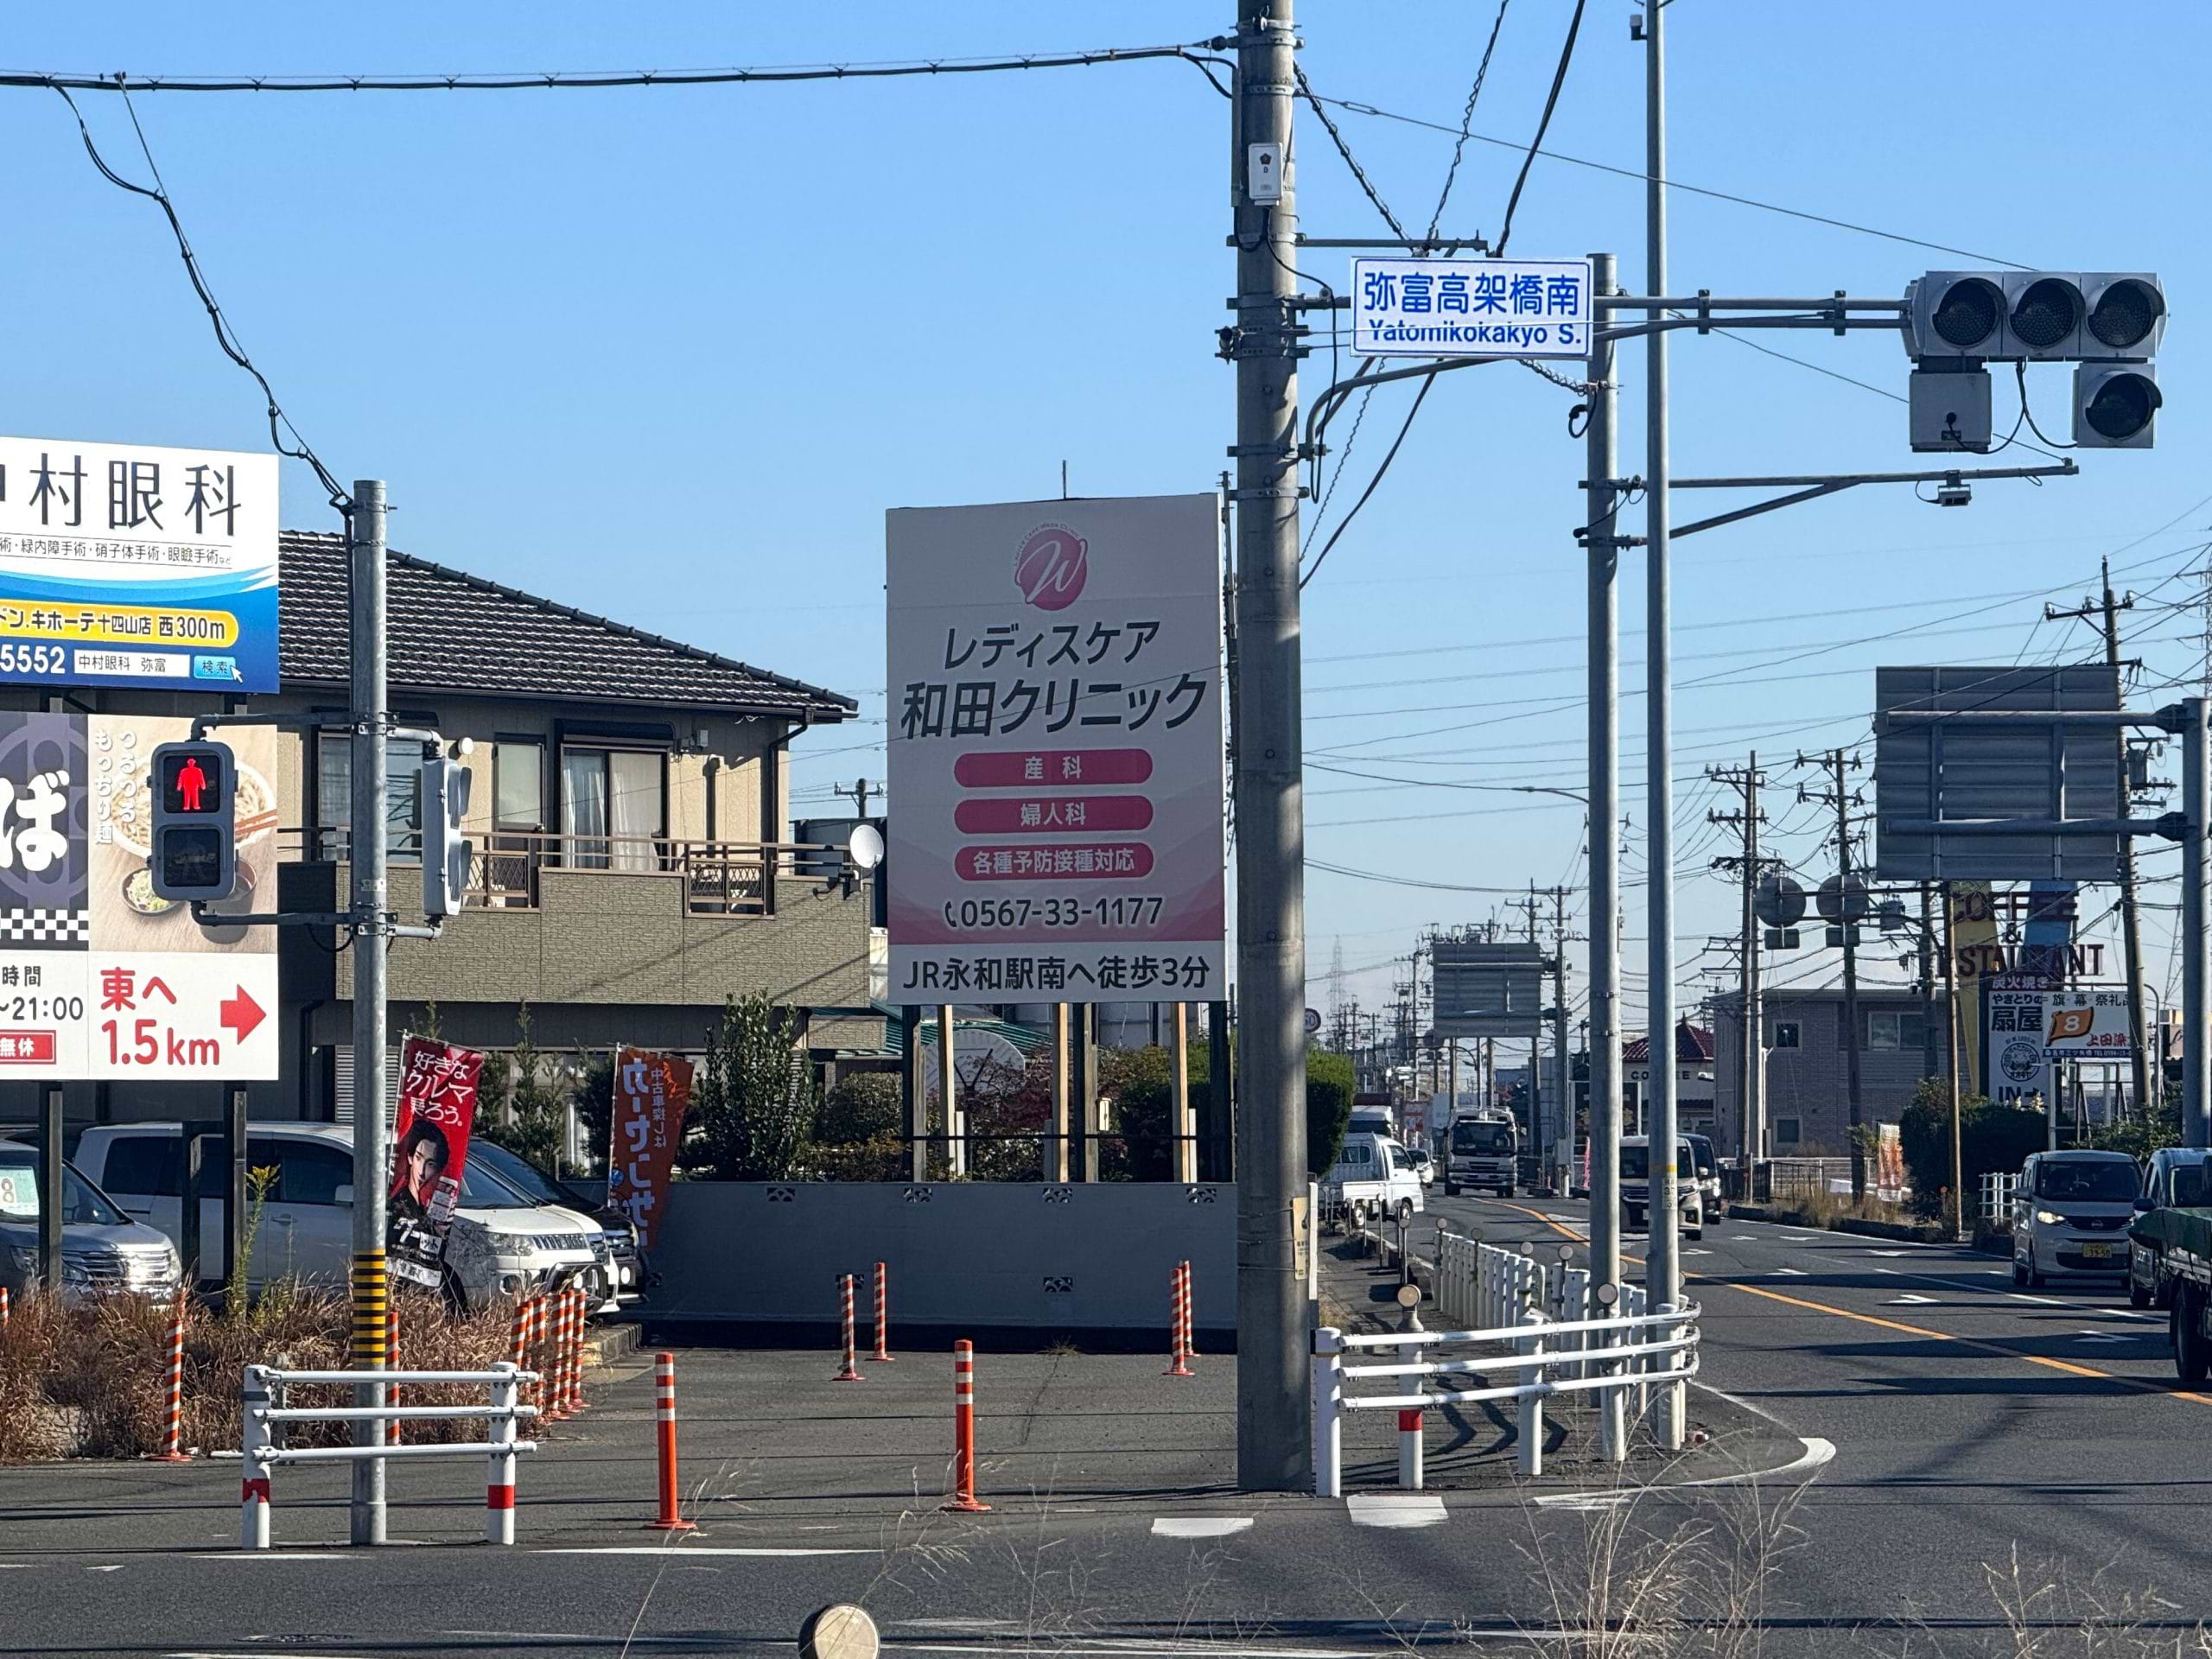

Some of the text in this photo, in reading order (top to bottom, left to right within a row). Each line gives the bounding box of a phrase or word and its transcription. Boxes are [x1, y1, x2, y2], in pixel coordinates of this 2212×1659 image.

[1364, 271, 1580, 316] 弥富高架橋南
[1370, 320, 1582, 347] Yatomikokakyo S.
[0, 452, 241, 537] 村眼科
[159, 616, 226, 639] 西300m
[0, 644, 66, 674] 5552
[944, 621, 1160, 670] レディスケア
[79, 653, 167, 673] 中村眼科 弥富
[202, 659, 230, 675] 検索
[901, 674, 1207, 740] 和田クリニック
[96, 729, 113, 844] もっちり麺
[0, 769, 70, 872] ば
[1020, 802, 1086, 826] 婦人科
[973, 849, 1135, 875] 各種予防接種対応
[960, 896, 1163, 927] 0567-33-1177
[3, 964, 41, 987] 時間
[903, 955, 1210, 991] JR永和駅南へ徒歩3分
[100, 967, 177, 1011] 東へ
[1992, 1006, 2044, 1032] 扇屋
[0, 1038, 35, 1058] 無休
[413, 1051, 470, 1080] 好きな
[406, 1069, 474, 1104] クルマ
[410, 1096, 463, 1127] 乗ろう。
